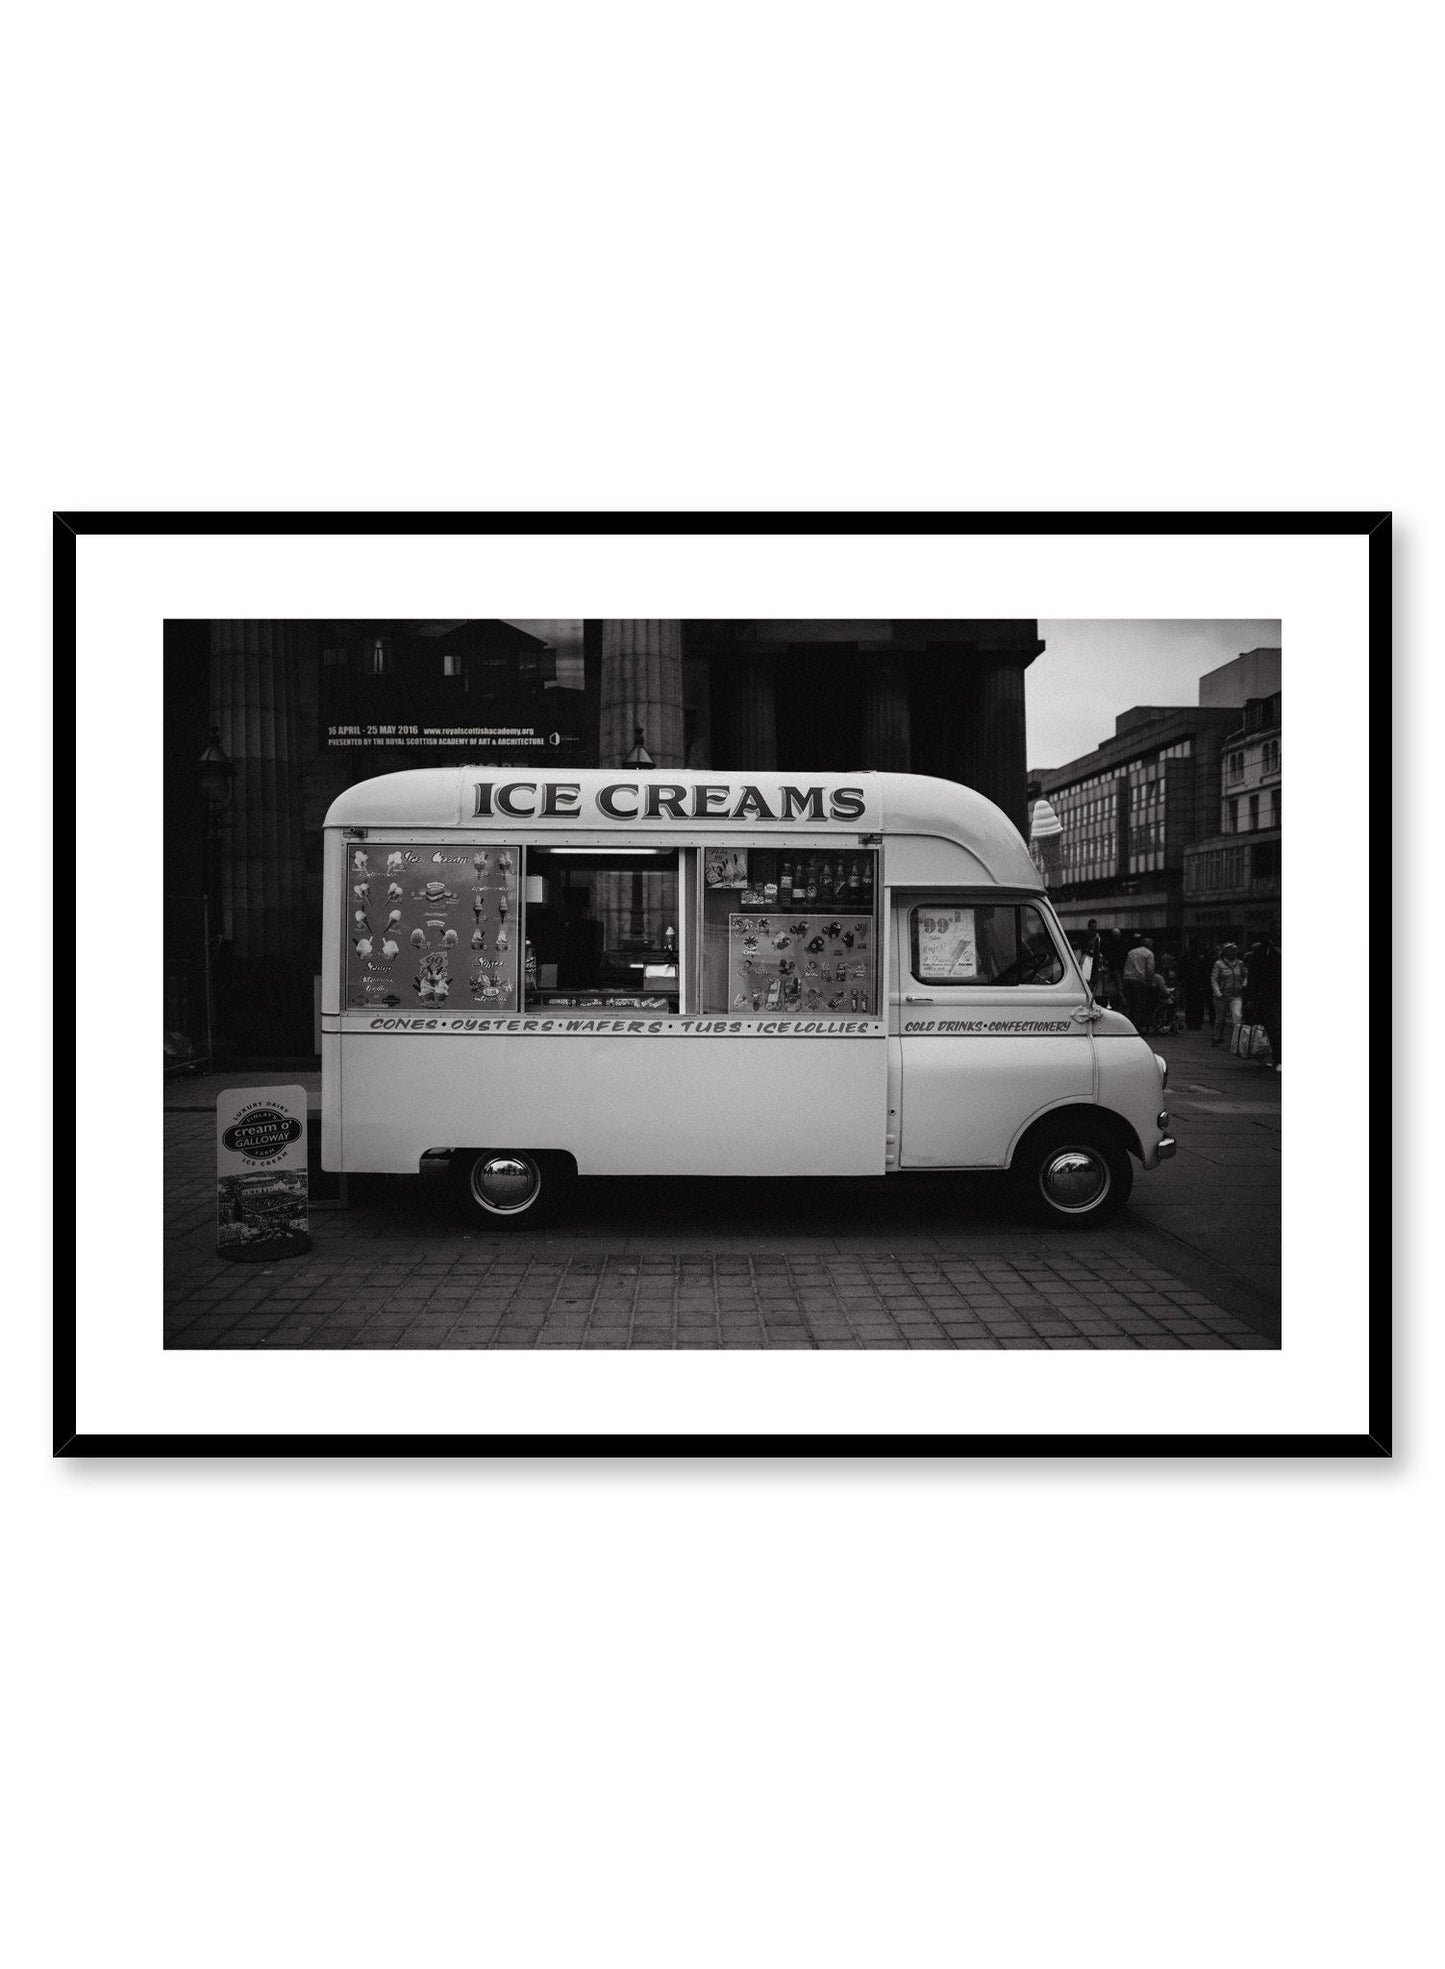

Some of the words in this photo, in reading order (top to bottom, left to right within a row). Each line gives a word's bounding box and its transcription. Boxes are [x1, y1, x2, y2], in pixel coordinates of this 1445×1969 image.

[328, 726, 337, 735] 16
[338, 725, 361, 735] APRIL
[367, 725, 379, 735] 25
[380, 725, 397, 735] MAY
[398, 725, 418, 735] 2016
[424, 727, 535, 736] www.royalscottishacademy.org
[328, 738, 362, 746] PRESENTED
[364, 738, 372, 746] BY
[374, 738, 385, 746] THE
[386, 738, 405, 746] ROYAL
[406, 738, 438, 746] SCOTTISH
[438, 738, 468, 746] ACADEMY
[470, 738, 477, 746] OF
[478, 738, 490, 746] ART
[498, 738, 545, 746] ARCHITECTURE
[472, 782, 582, 819] ICE
[596, 784, 865, 822] CREAMS
[403, 850, 423, 864] Ice
[432, 850, 470, 864] Cream
[370, 1018, 437, 1030] CONES
[451, 1019, 554, 1032] OYSTERS
[566, 1020, 663, 1033] WAFERS
[681, 1021, 743, 1033] TUBS
[904, 1021, 936, 1032] COLD
[937, 1021, 984, 1032] DRINKS
[987, 1021, 1072, 1032] CONFECTIONERY
[233, 1102, 263, 1121] LUXURY
[266, 1101, 290, 1113] DAIRY
[234, 1123, 277, 1137] cream
[235, 1132, 290, 1148] GALLOWAY
[242, 1158, 256, 1166] ICE
[260, 1151, 288, 1167] CREAM
